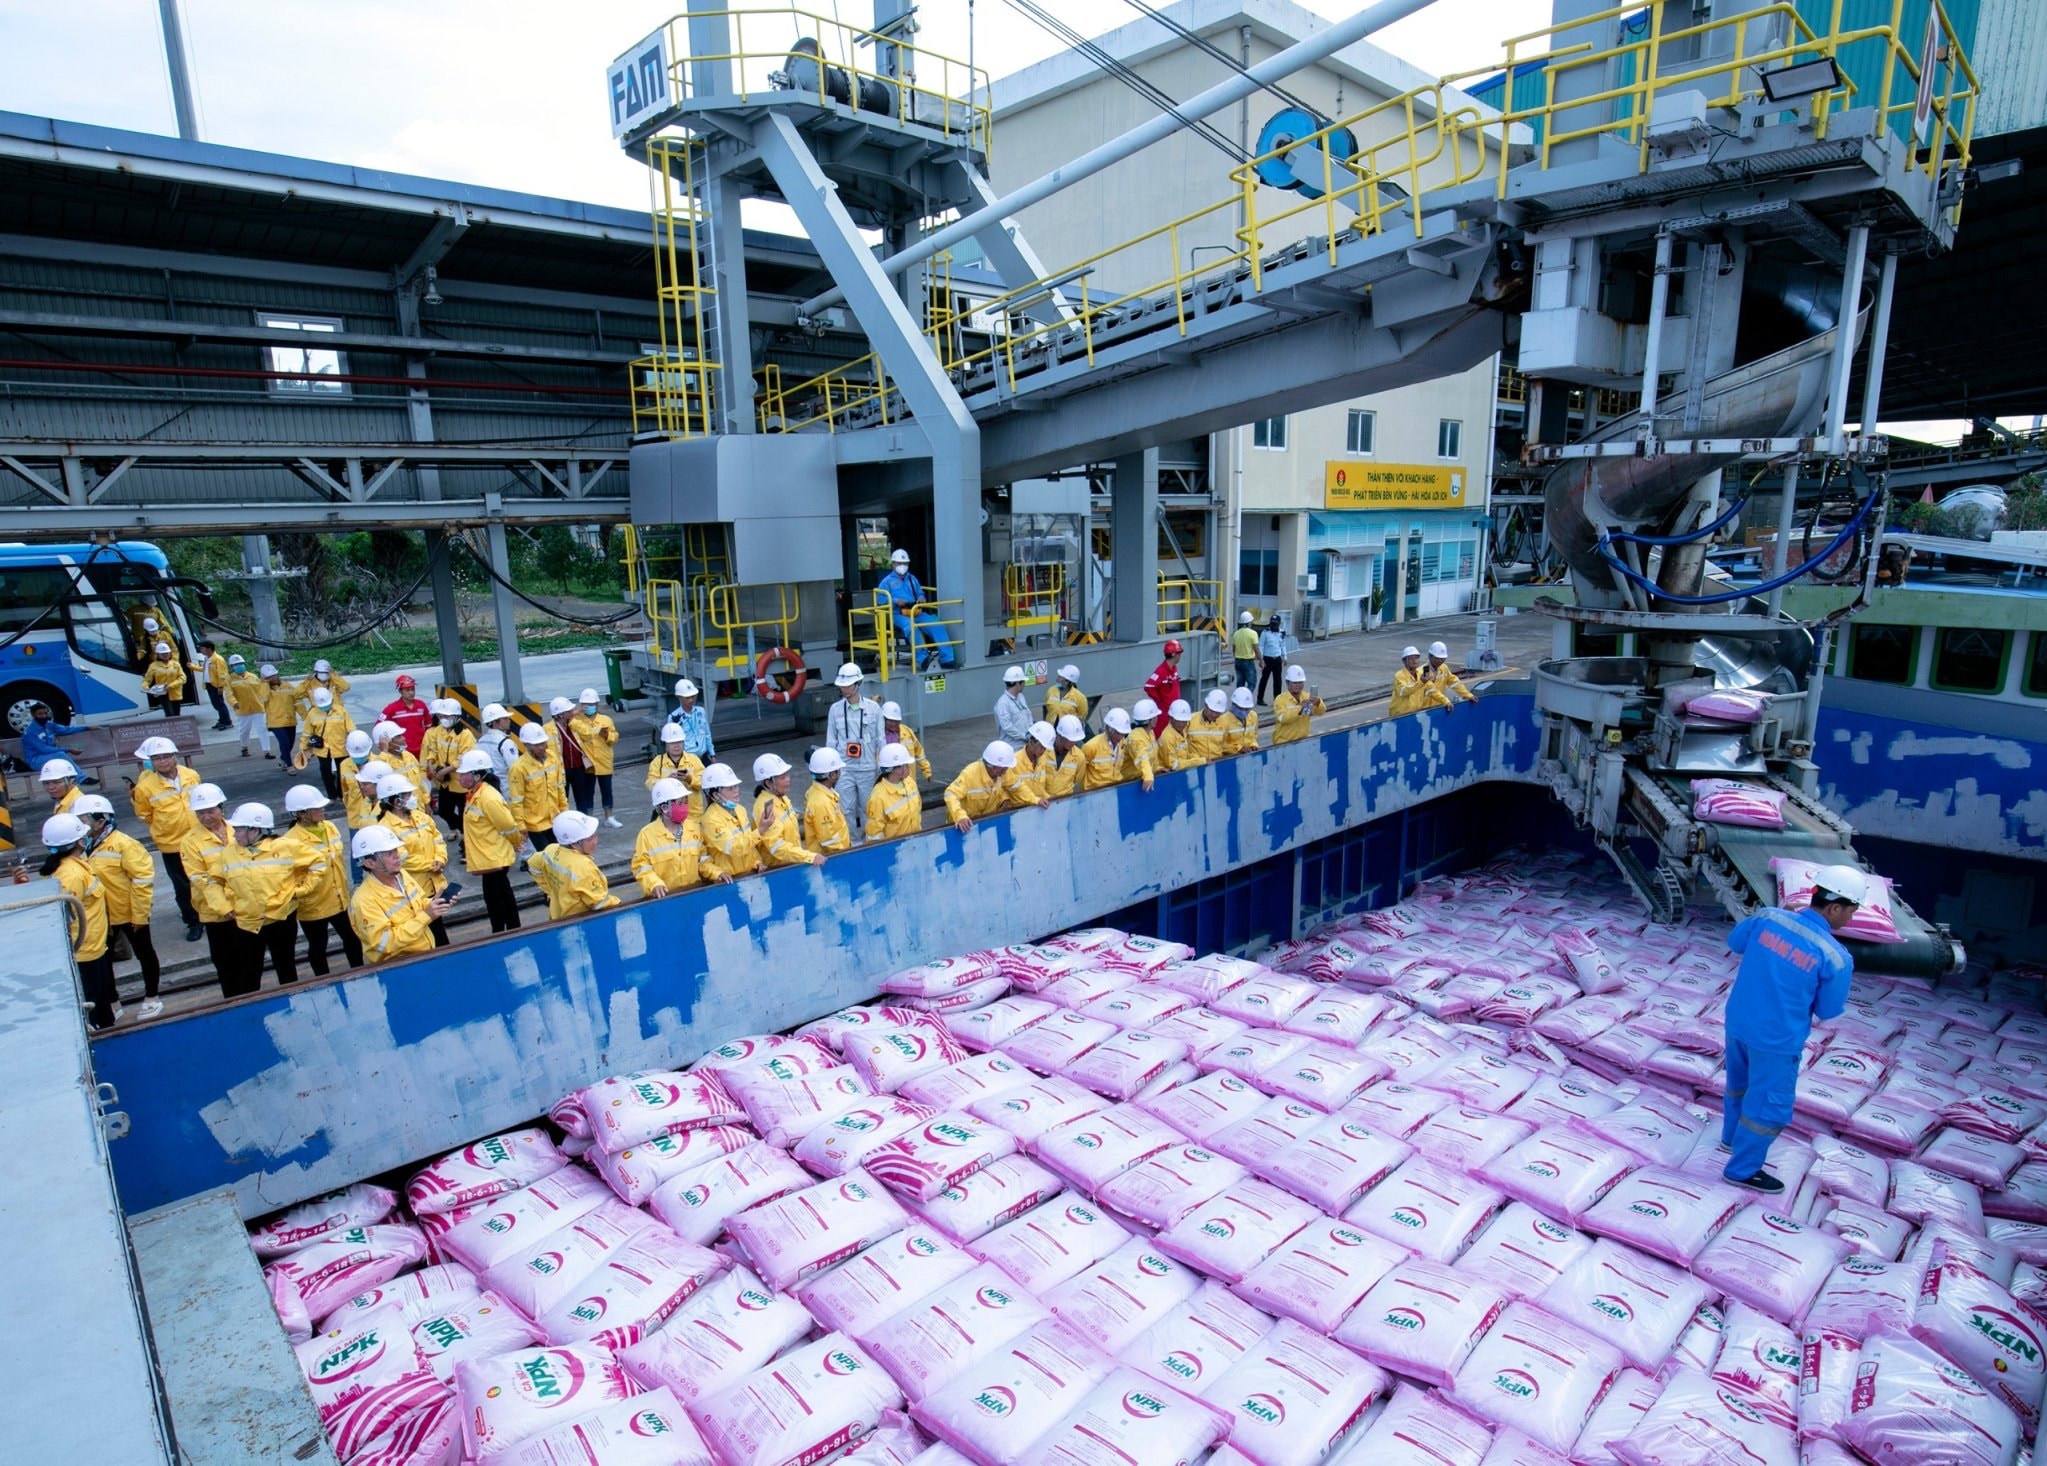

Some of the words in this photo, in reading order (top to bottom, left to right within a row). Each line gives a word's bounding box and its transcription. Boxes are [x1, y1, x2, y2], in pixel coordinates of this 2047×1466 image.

[611, 44, 665, 126] FAM
[1130, 940, 1160, 949] NPK
[1509, 988, 1534, 998] NPK
[888, 1035, 916, 1056] NPK
[1487, 1054, 1507, 1066] NPK
[1827, 1057, 1861, 1070] NPK
[1225, 1078, 1245, 1090] NPK
[1297, 1071, 1319, 1083] NPK
[636, 1084, 665, 1104] NPK
[843, 1078, 861, 1094] NPK
[1563, 1083, 1588, 1095] NPK
[1293, 1105, 1313, 1116] NPK
[1989, 1095, 2028, 1113] NPK
[672, 1120, 706, 1134] 18-6-18
[835, 1117, 873, 1131] NPK
[1346, 1124, 1372, 1137] NPK
[934, 1124, 976, 1141] NPK
[1075, 1134, 1096, 1148] NPK
[482, 1138, 510, 1164] NPK
[1190, 1148, 1214, 1160] NPK
[1844, 1146, 1866, 1157] NPK
[950, 1164, 979, 1185] 18-6-18
[1525, 1165, 1553, 1177] NPK
[461, 1185, 498, 1201] 18-6-18
[680, 1190, 700, 1206] NPK
[849, 1183, 870, 1200] NPK
[1073, 1206, 1097, 1222] NPK
[1630, 1204, 1661, 1217] NPK
[484, 1219, 507, 1232] NPK
[1391, 1211, 1422, 1227] NPK
[1769, 1216, 1801, 1230] NPK
[1201, 1223, 1229, 1238] NPK
[1336, 1229, 1366, 1243] NPK
[1540, 1222, 1570, 1239] NPK
[914, 1238, 938, 1254] NPK
[532, 1258, 554, 1274] NPK
[1144, 1256, 1170, 1273] NPK
[1850, 1263, 1886, 1271] NPK
[302, 1260, 348, 1287] 18-6-18
[661, 1284, 694, 1318] 18-6-18
[744, 1290, 771, 1306] NPK
[984, 1289, 1012, 1305] NPK
[570, 1306, 599, 1321] NPK
[1592, 1299, 1627, 1320] NPK
[1384, 1315, 1420, 1330] NPK
[422, 1317, 464, 1348] NPK
[1969, 1314, 2040, 1363] NPK
[320, 1332, 379, 1375] NPK
[832, 1352, 861, 1371] NPK
[1805, 1347, 1815, 1376] 18-6-18
[1163, 1356, 1196, 1377] NPK
[523, 1355, 561, 1398] NPK
[1493, 1375, 1533, 1396] NPK
[975, 1393, 1009, 1414] NPK
[1129, 1393, 1167, 1413] NPK
[1241, 1399, 1279, 1421] NPK
[1724, 1394, 1763, 1421] NPK
[643, 1413, 669, 1434] NPK
[804, 1434, 847, 1466] 18-6-18
